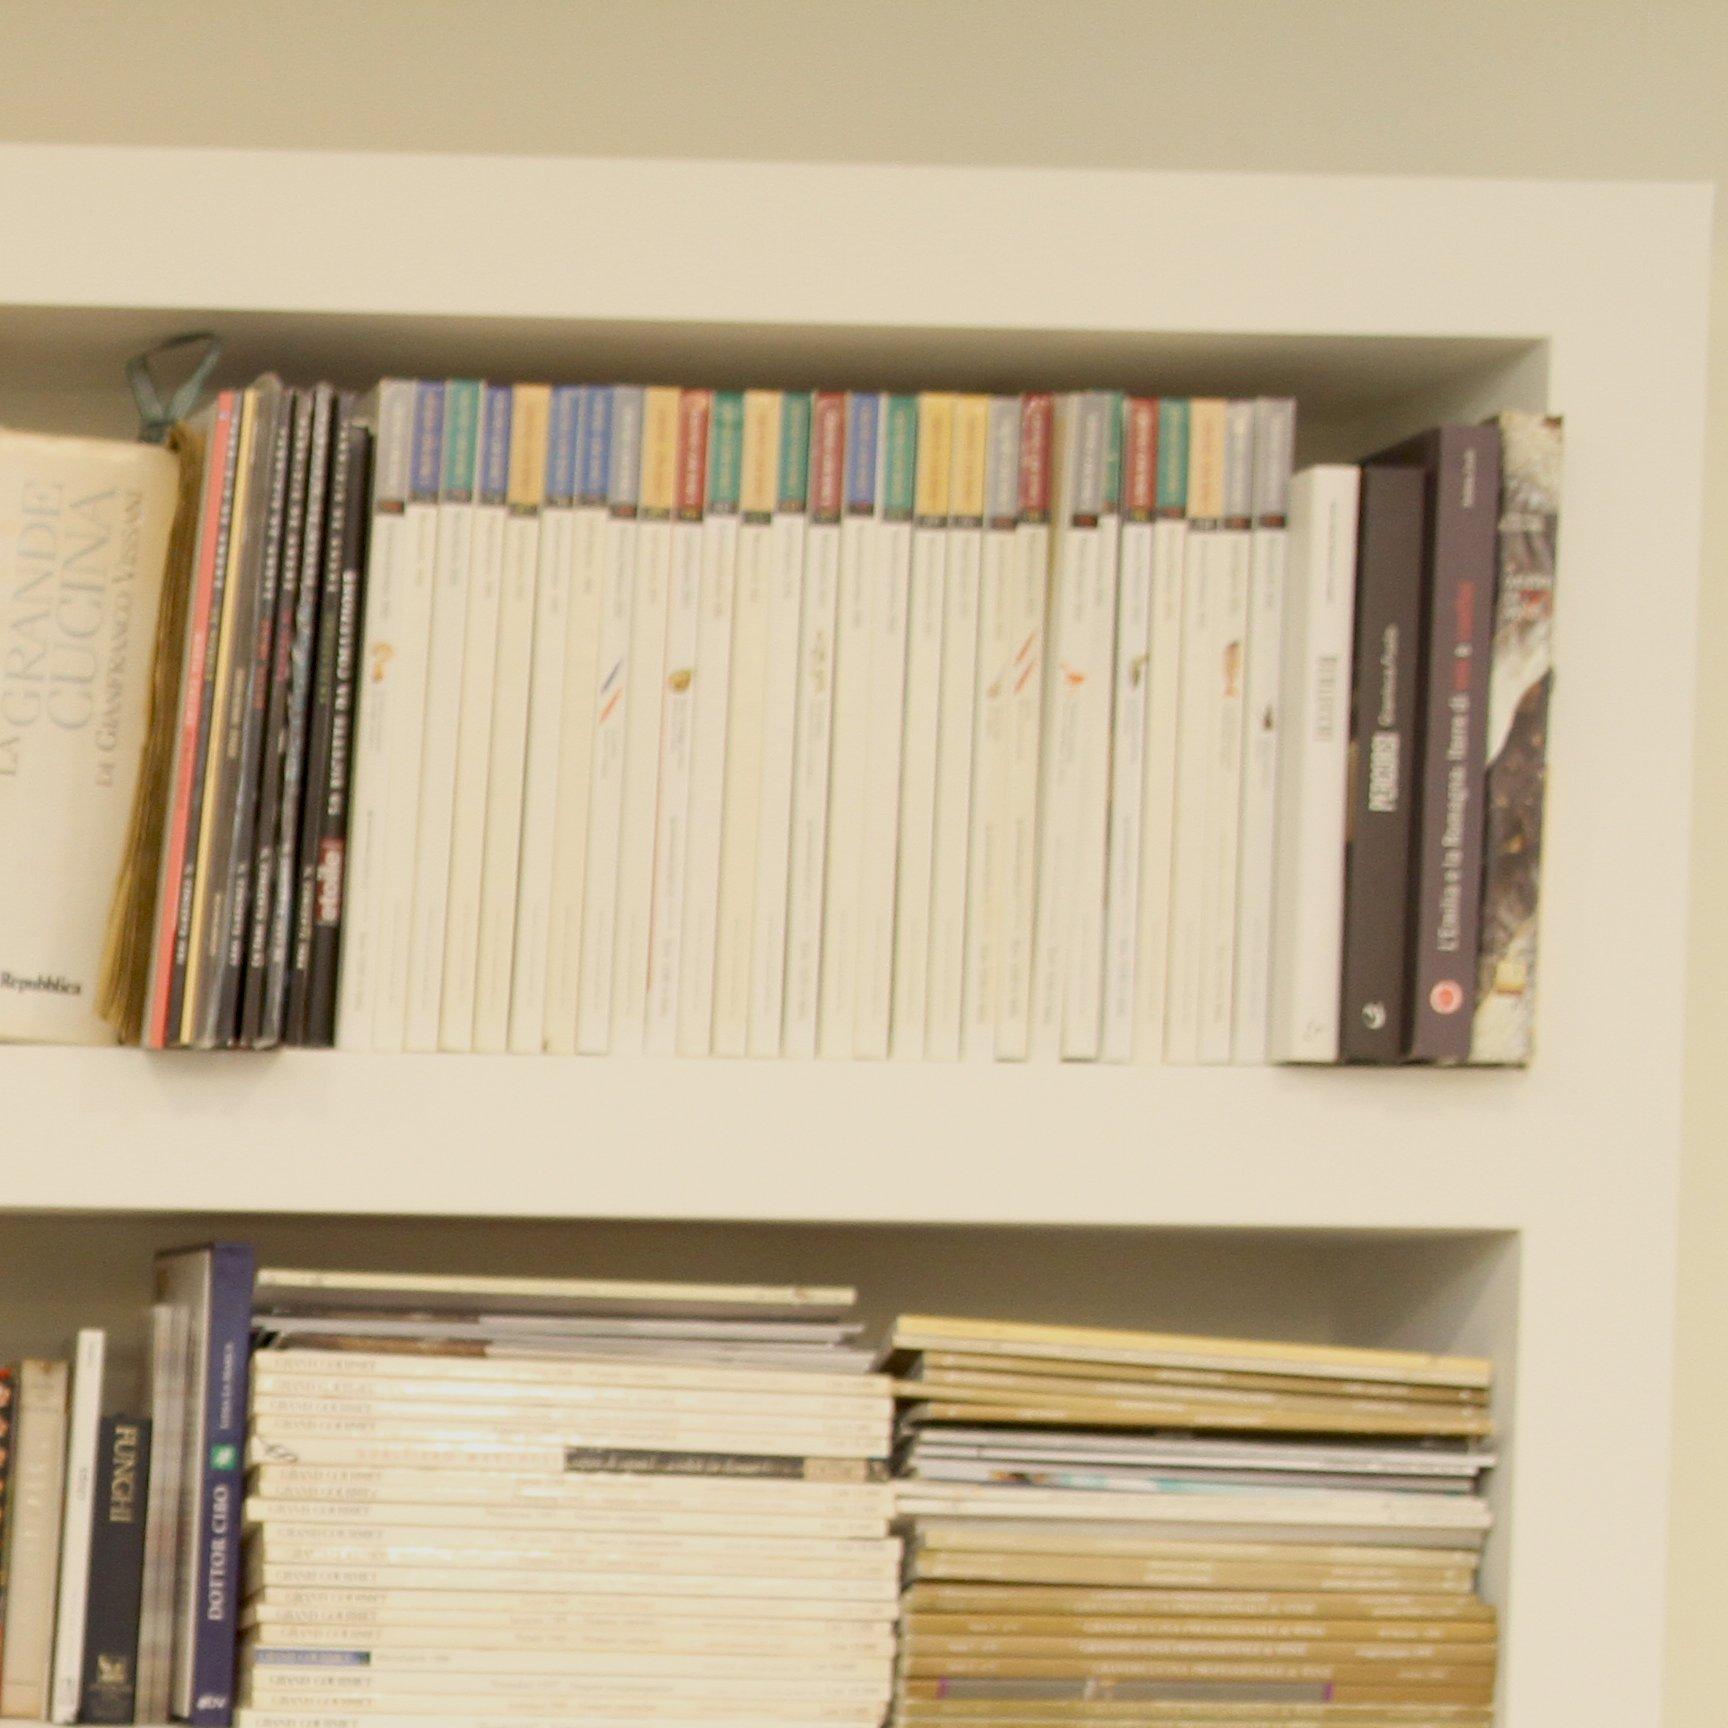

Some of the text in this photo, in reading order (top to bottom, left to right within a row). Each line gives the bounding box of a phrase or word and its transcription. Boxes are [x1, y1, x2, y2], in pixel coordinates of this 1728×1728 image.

[0, 480, 65, 726] GRANDE
[47, 486, 121, 730] CUCINA
[0, 971, 82, 997] Repubblica
[109, 1423, 141, 1522] FUNGHI
[207, 1483, 231, 1621] DOTTOR CIBO
